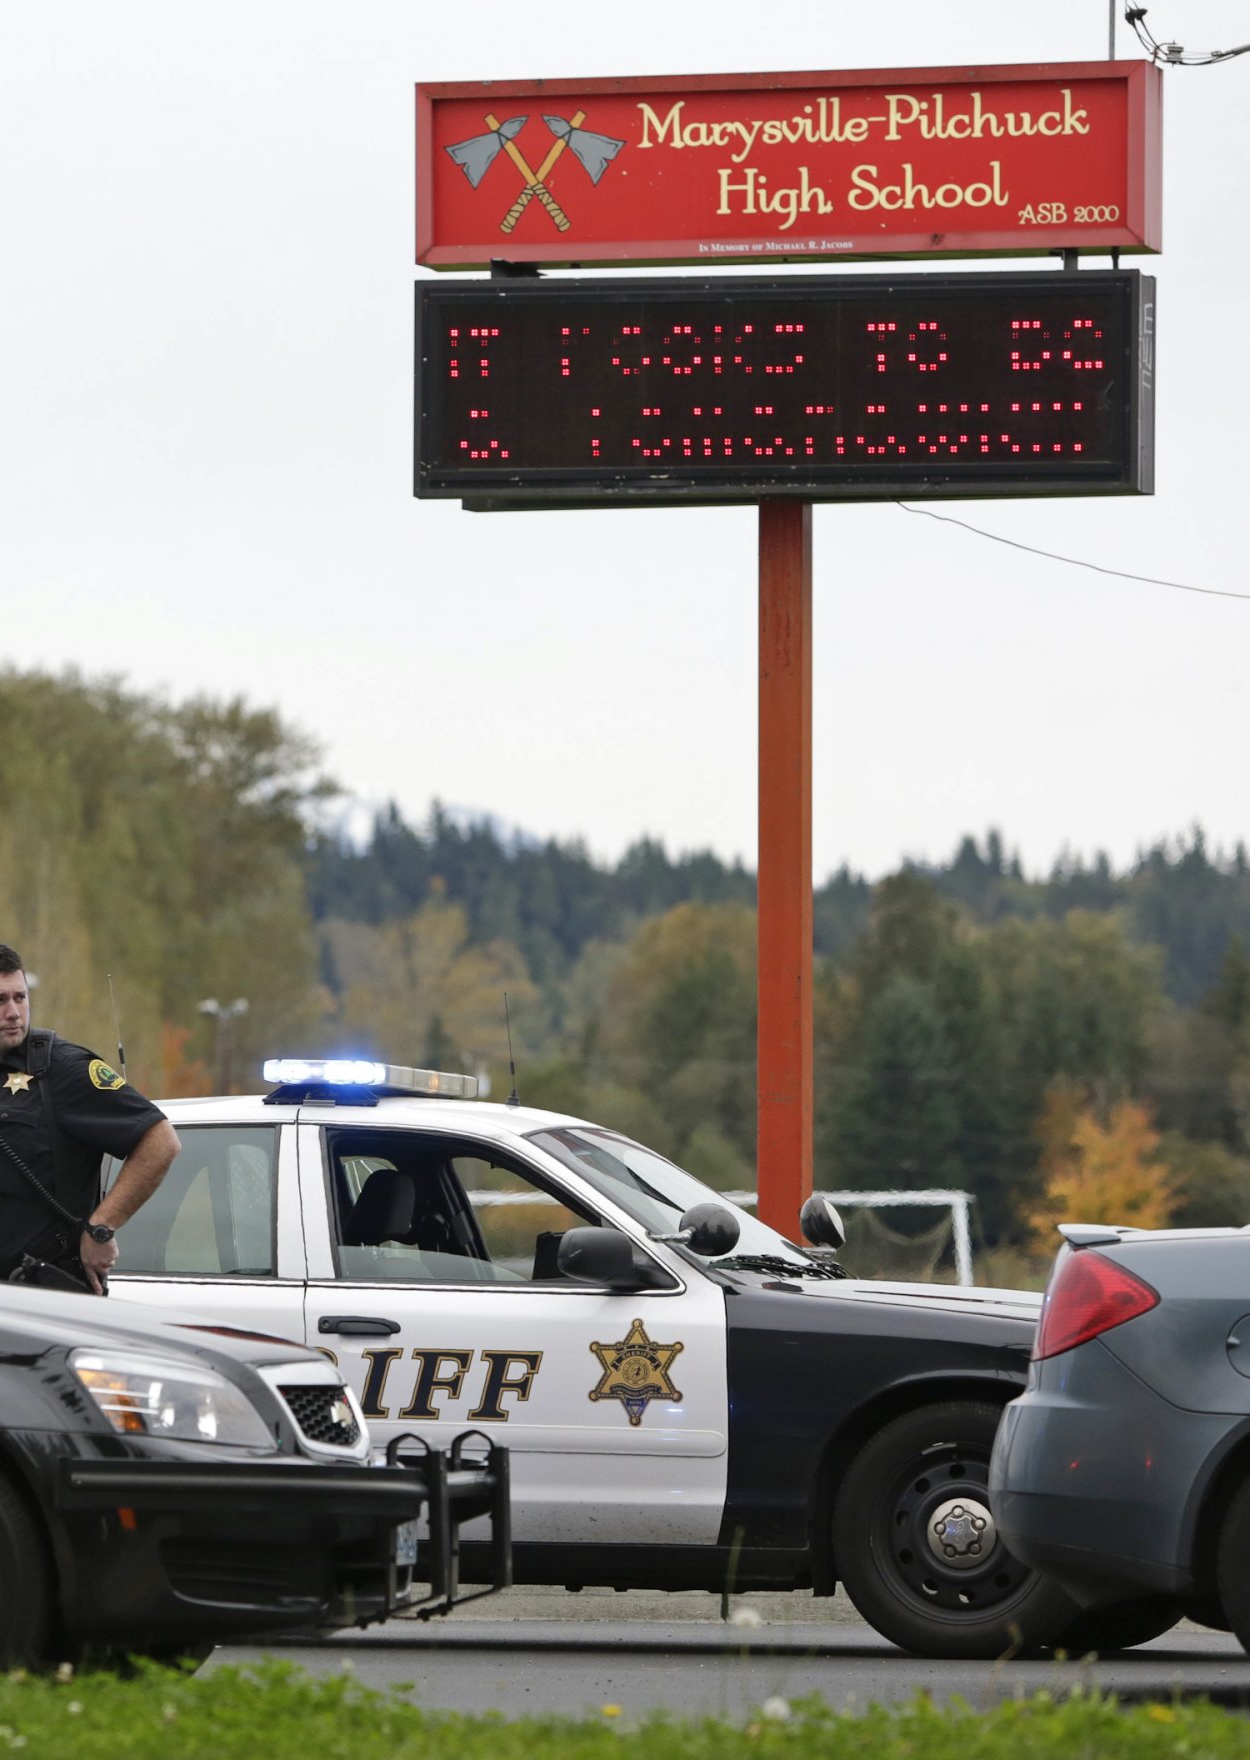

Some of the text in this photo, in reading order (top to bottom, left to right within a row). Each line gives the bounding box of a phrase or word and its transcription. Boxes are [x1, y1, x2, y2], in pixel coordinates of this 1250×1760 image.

[636, 88, 1091, 163] Marysville-Pilchuck
[716, 160, 1009, 231] High School
[1018, 202, 1120, 225] ASB 2000
[318, 1347, 544, 1422] IFF
